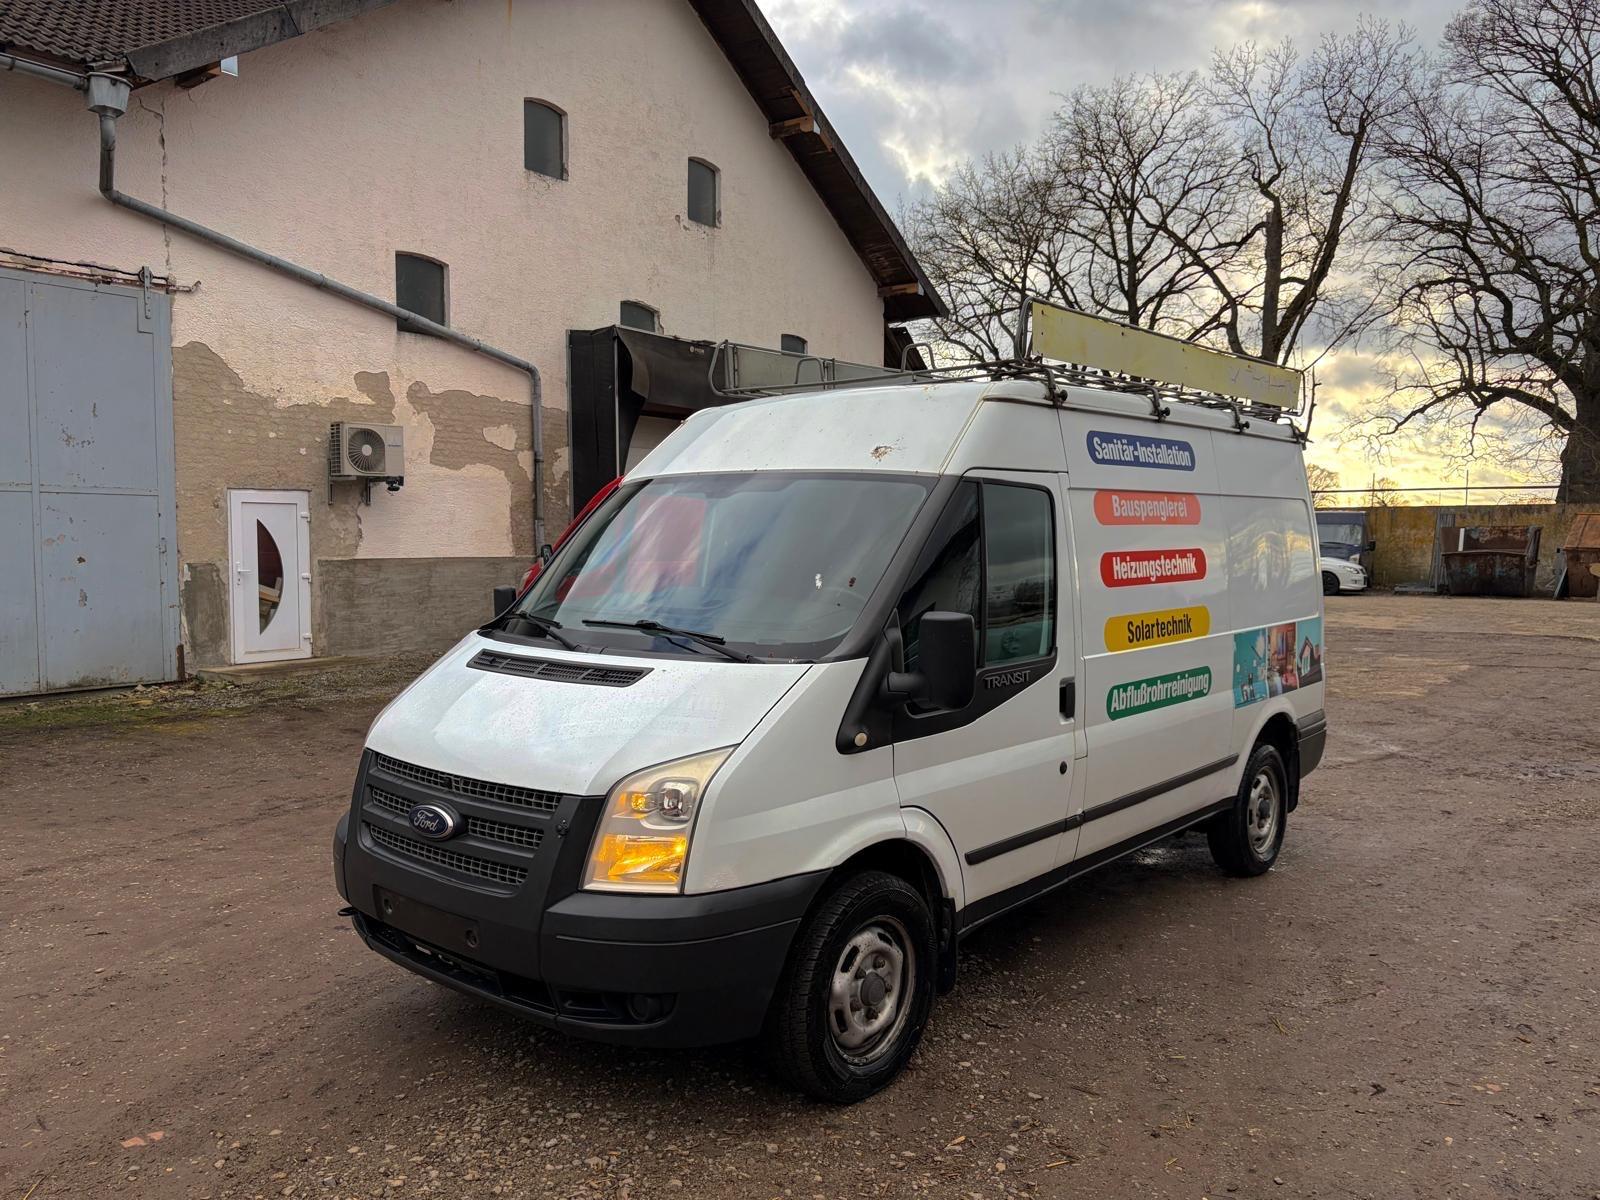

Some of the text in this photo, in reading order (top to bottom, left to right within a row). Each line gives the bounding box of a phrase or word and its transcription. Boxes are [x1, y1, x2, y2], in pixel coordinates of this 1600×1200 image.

[1093, 436, 1191, 466] Sanitär-Installation
[1112, 495, 1187, 520] Bauspenglerei
[1112, 554, 1197, 581] Heizungstechnik
[1127, 613, 1192, 643] Solartechnik
[984, 670, 1031, 689] TRANSIT
[1111, 673, 1209, 712] Abflußrohrreinigung
[413, 810, 439, 831] Ford
